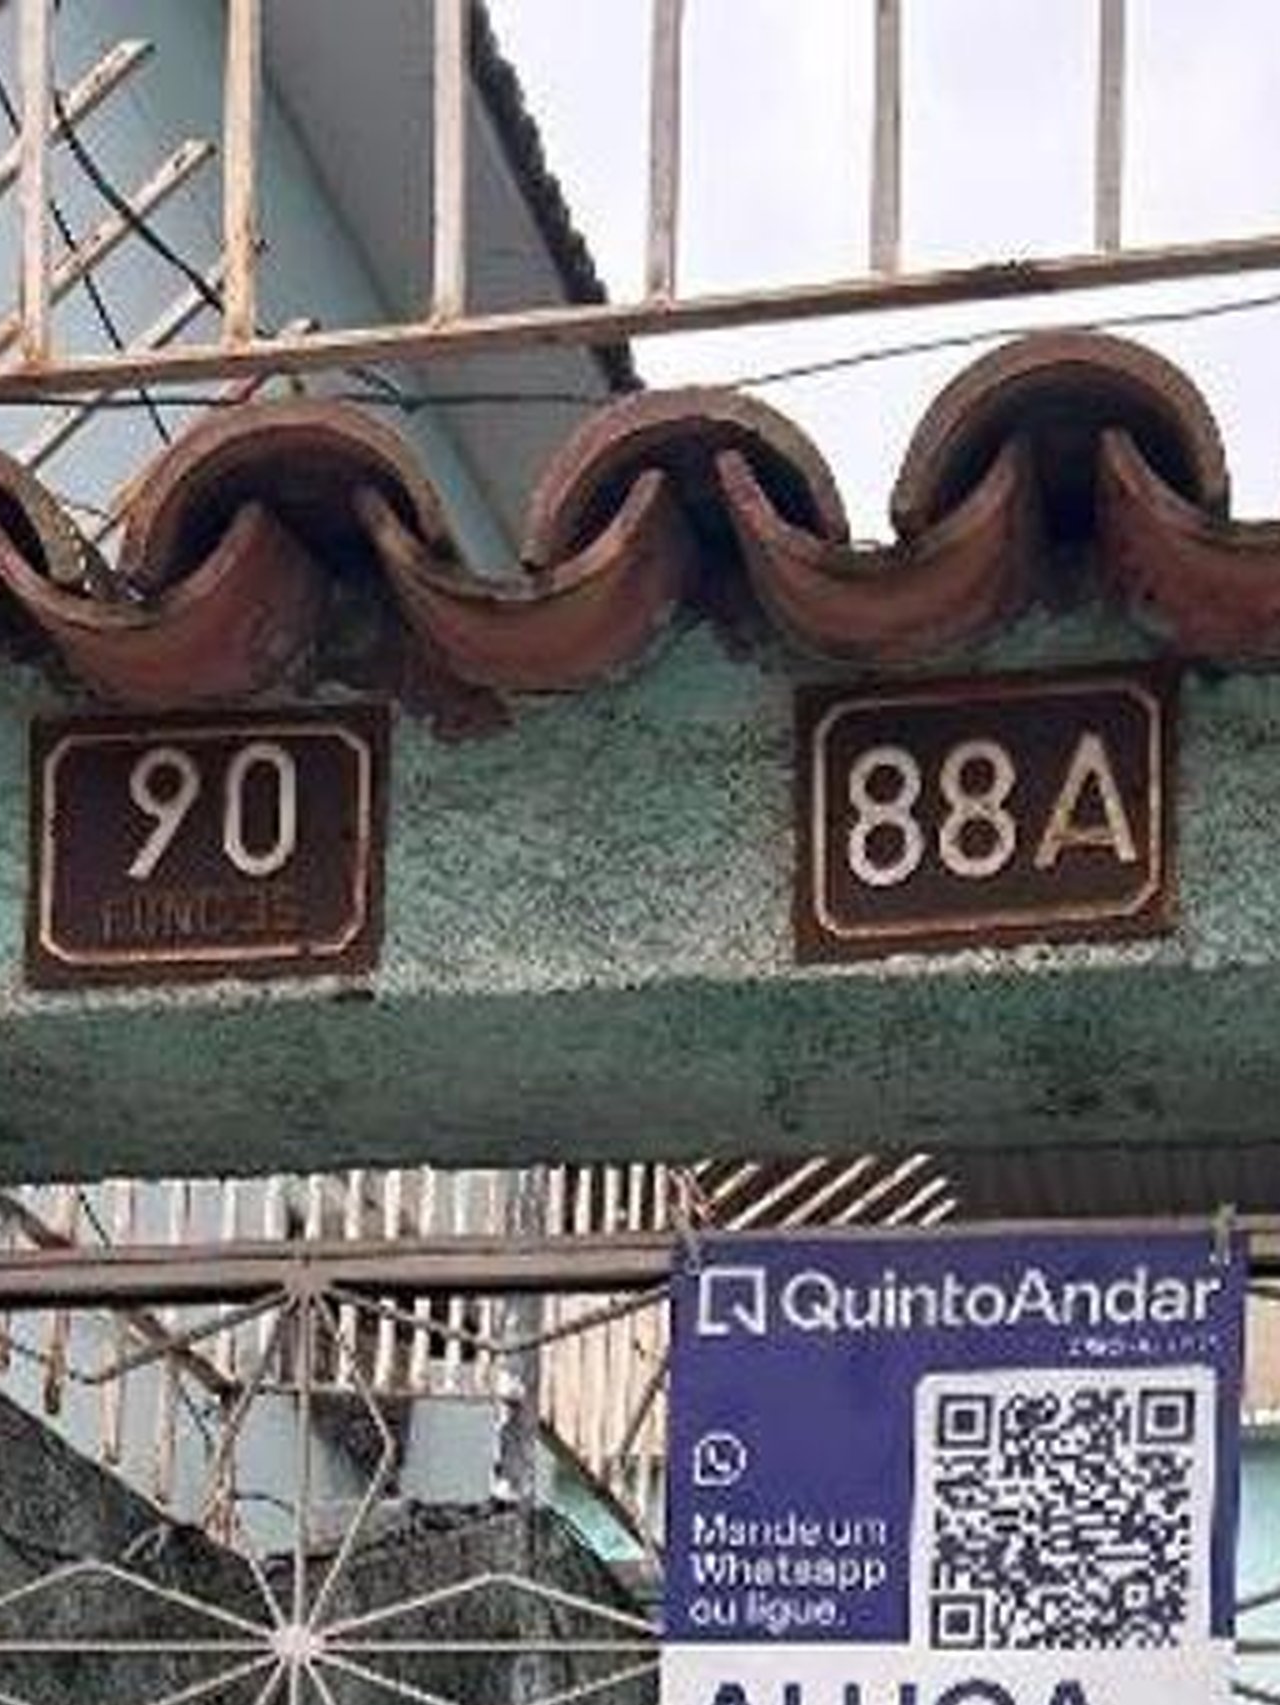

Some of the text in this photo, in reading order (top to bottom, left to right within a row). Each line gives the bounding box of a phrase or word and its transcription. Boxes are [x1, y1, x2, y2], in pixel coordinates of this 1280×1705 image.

[126, 743, 297, 880] 90
[848, 732, 1137, 887] 88A
[781, 1267, 1222, 1331] QuintoAndar
[692, 1512, 887, 1547] Mande um
[689, 1597, 736, 1626] ou
